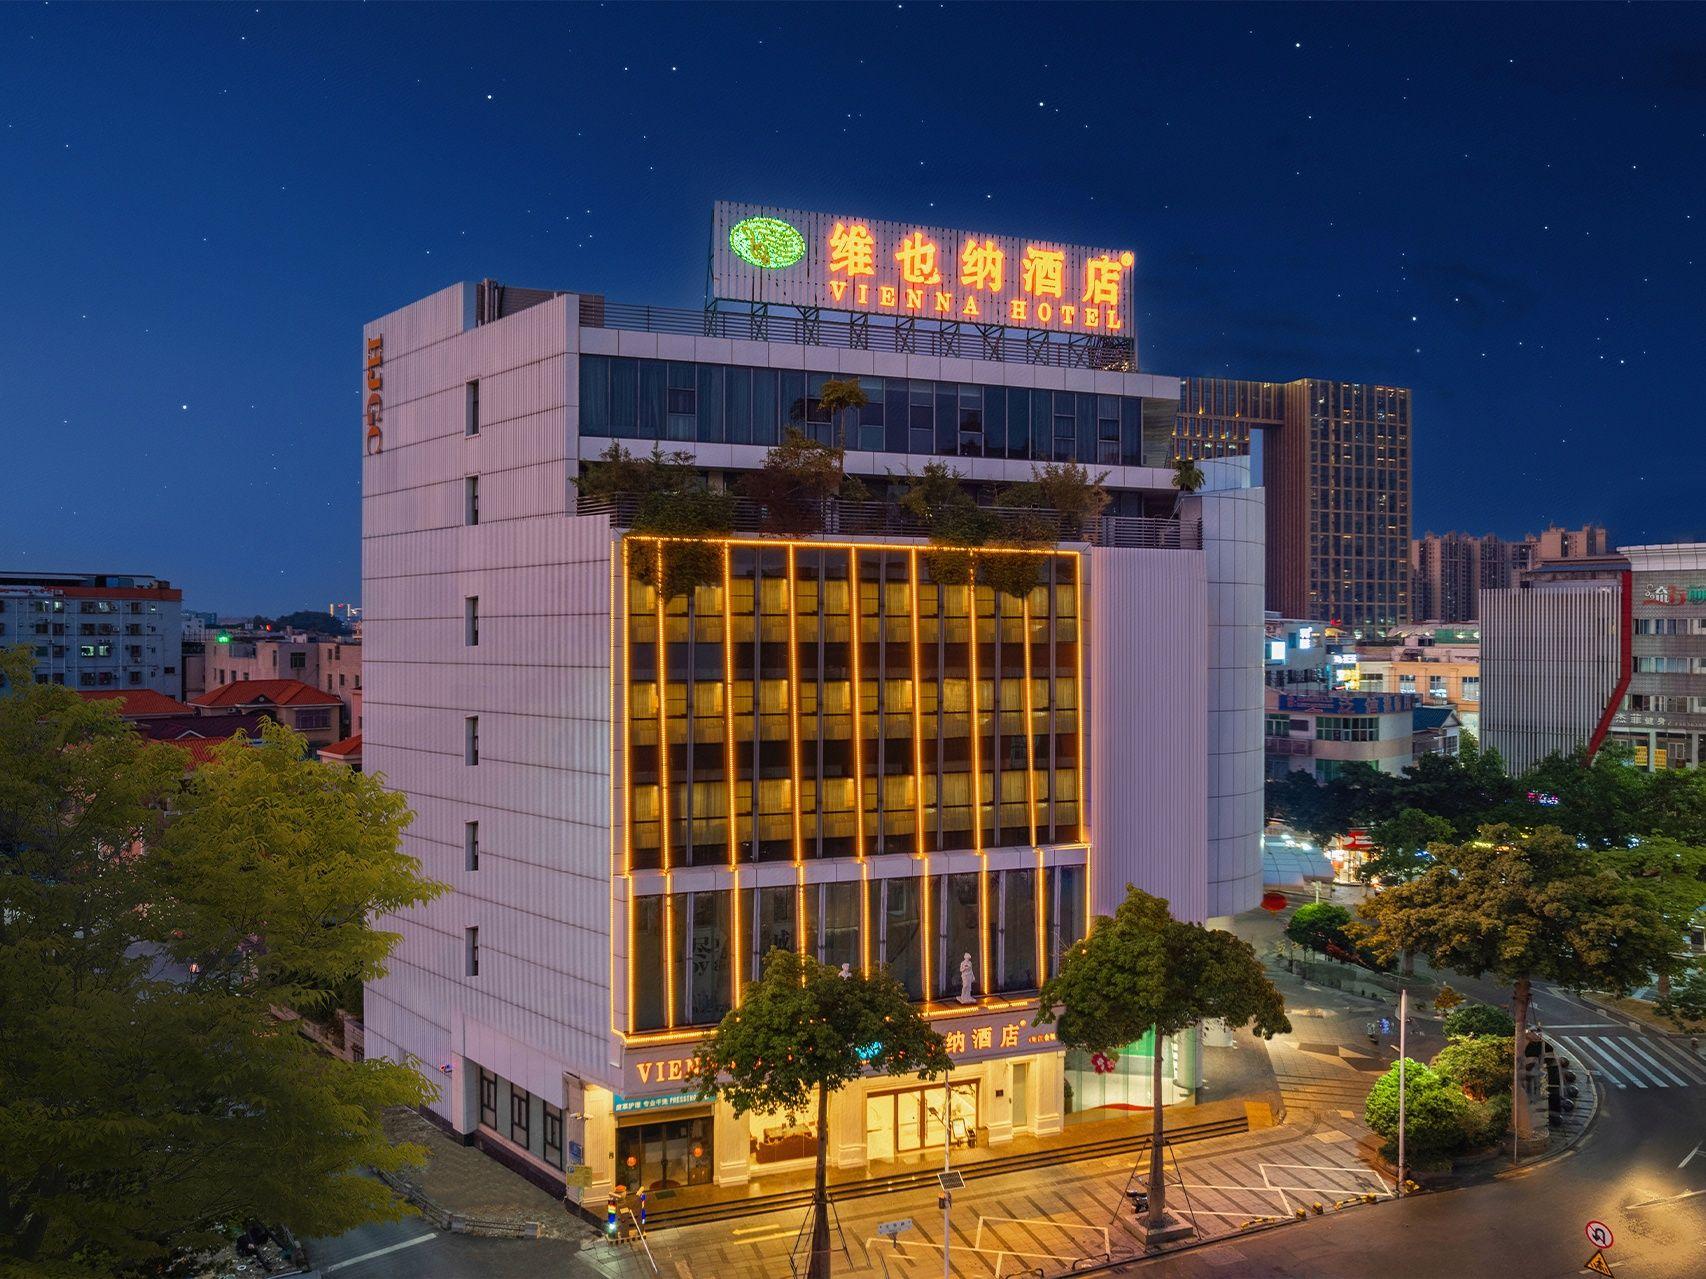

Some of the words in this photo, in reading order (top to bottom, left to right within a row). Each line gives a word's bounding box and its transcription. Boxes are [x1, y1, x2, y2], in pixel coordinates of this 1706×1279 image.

[829, 222, 1122, 306] 维也纳酒店
[829, 280, 980, 316] VIENNA
[1010, 300, 1121, 330] HOTEL
[945, 1024, 1019, 1054] 纳酒店
[636, 1056, 704, 1085] VIEN
